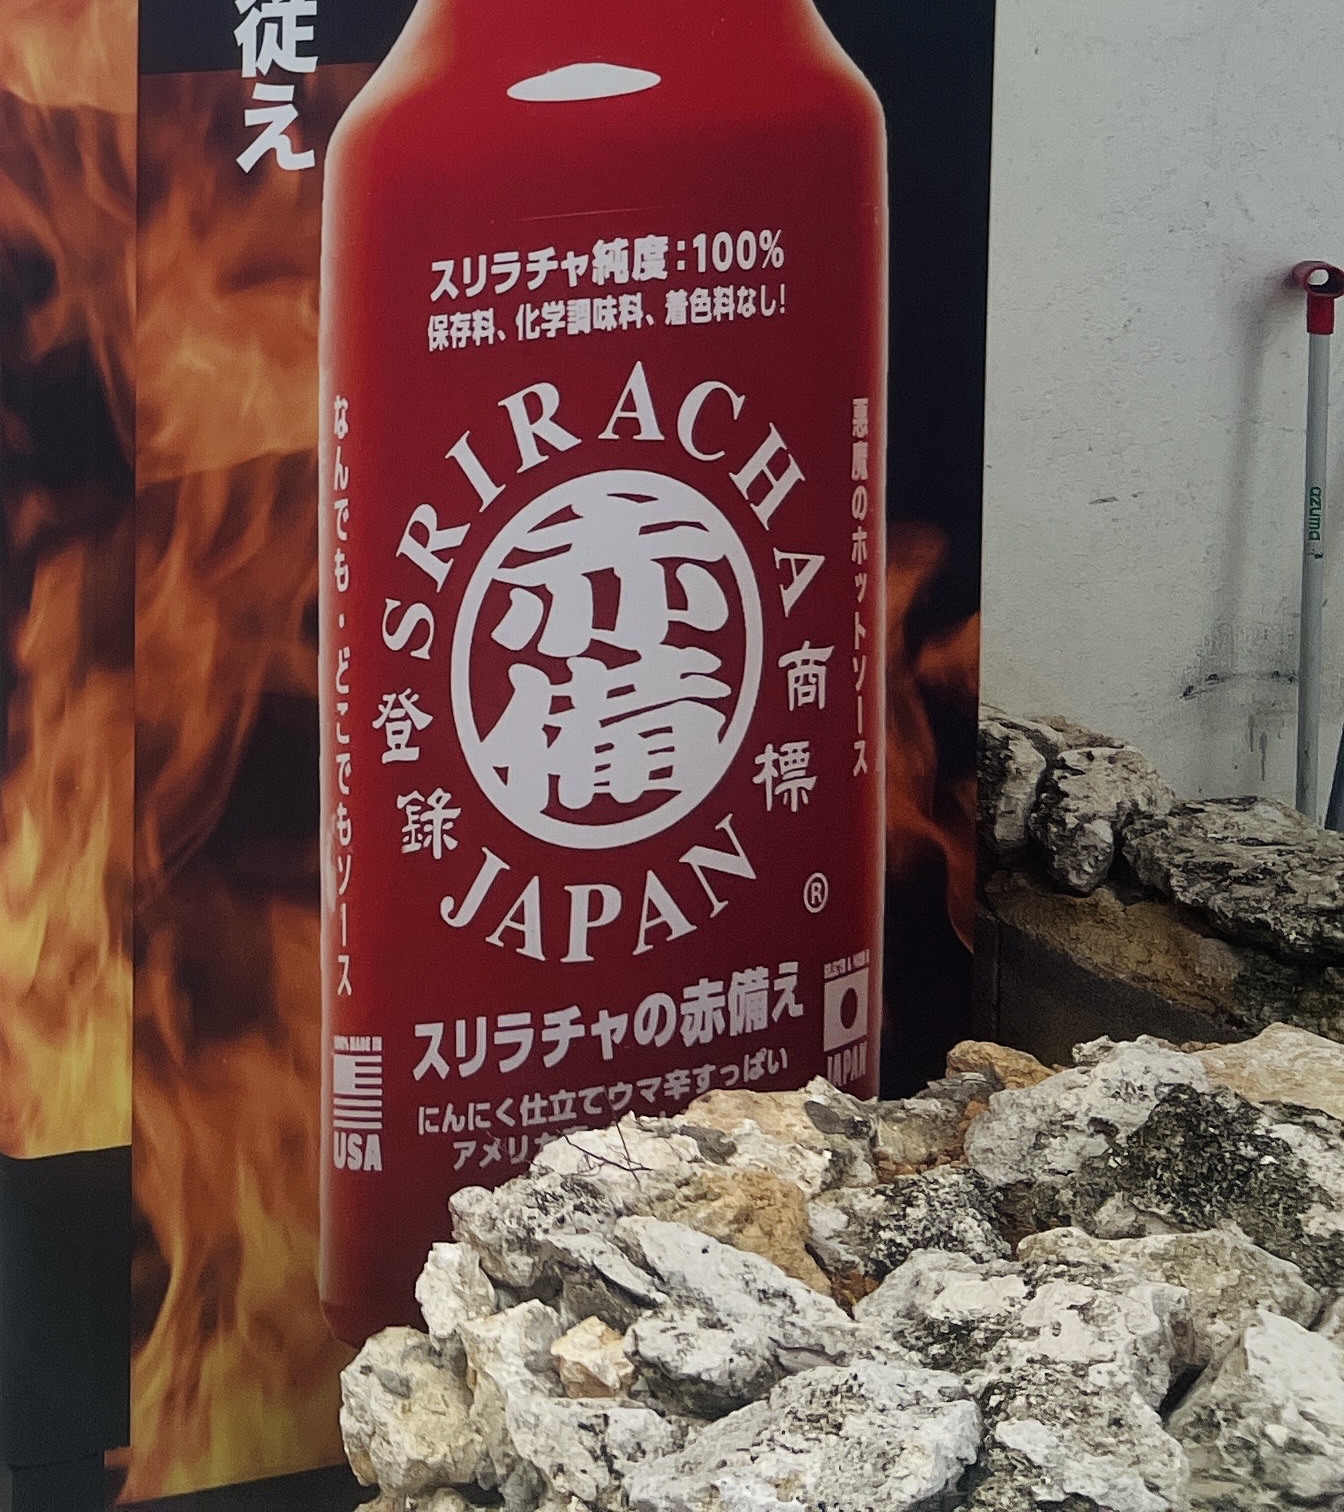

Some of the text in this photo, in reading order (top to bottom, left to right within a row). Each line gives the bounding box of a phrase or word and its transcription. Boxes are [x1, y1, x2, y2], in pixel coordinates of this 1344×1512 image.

[430, 229, 785, 301] スリラチャ純度:100%
[382, 361, 825, 659] SRIRACHA
[851, 397, 869, 777] 悪魔のホットソース
[441, 814, 756, 963] JAPAN
[412, 961, 805, 1081] スリラチャの赤備え
[333, 1131, 382, 1171] USA
